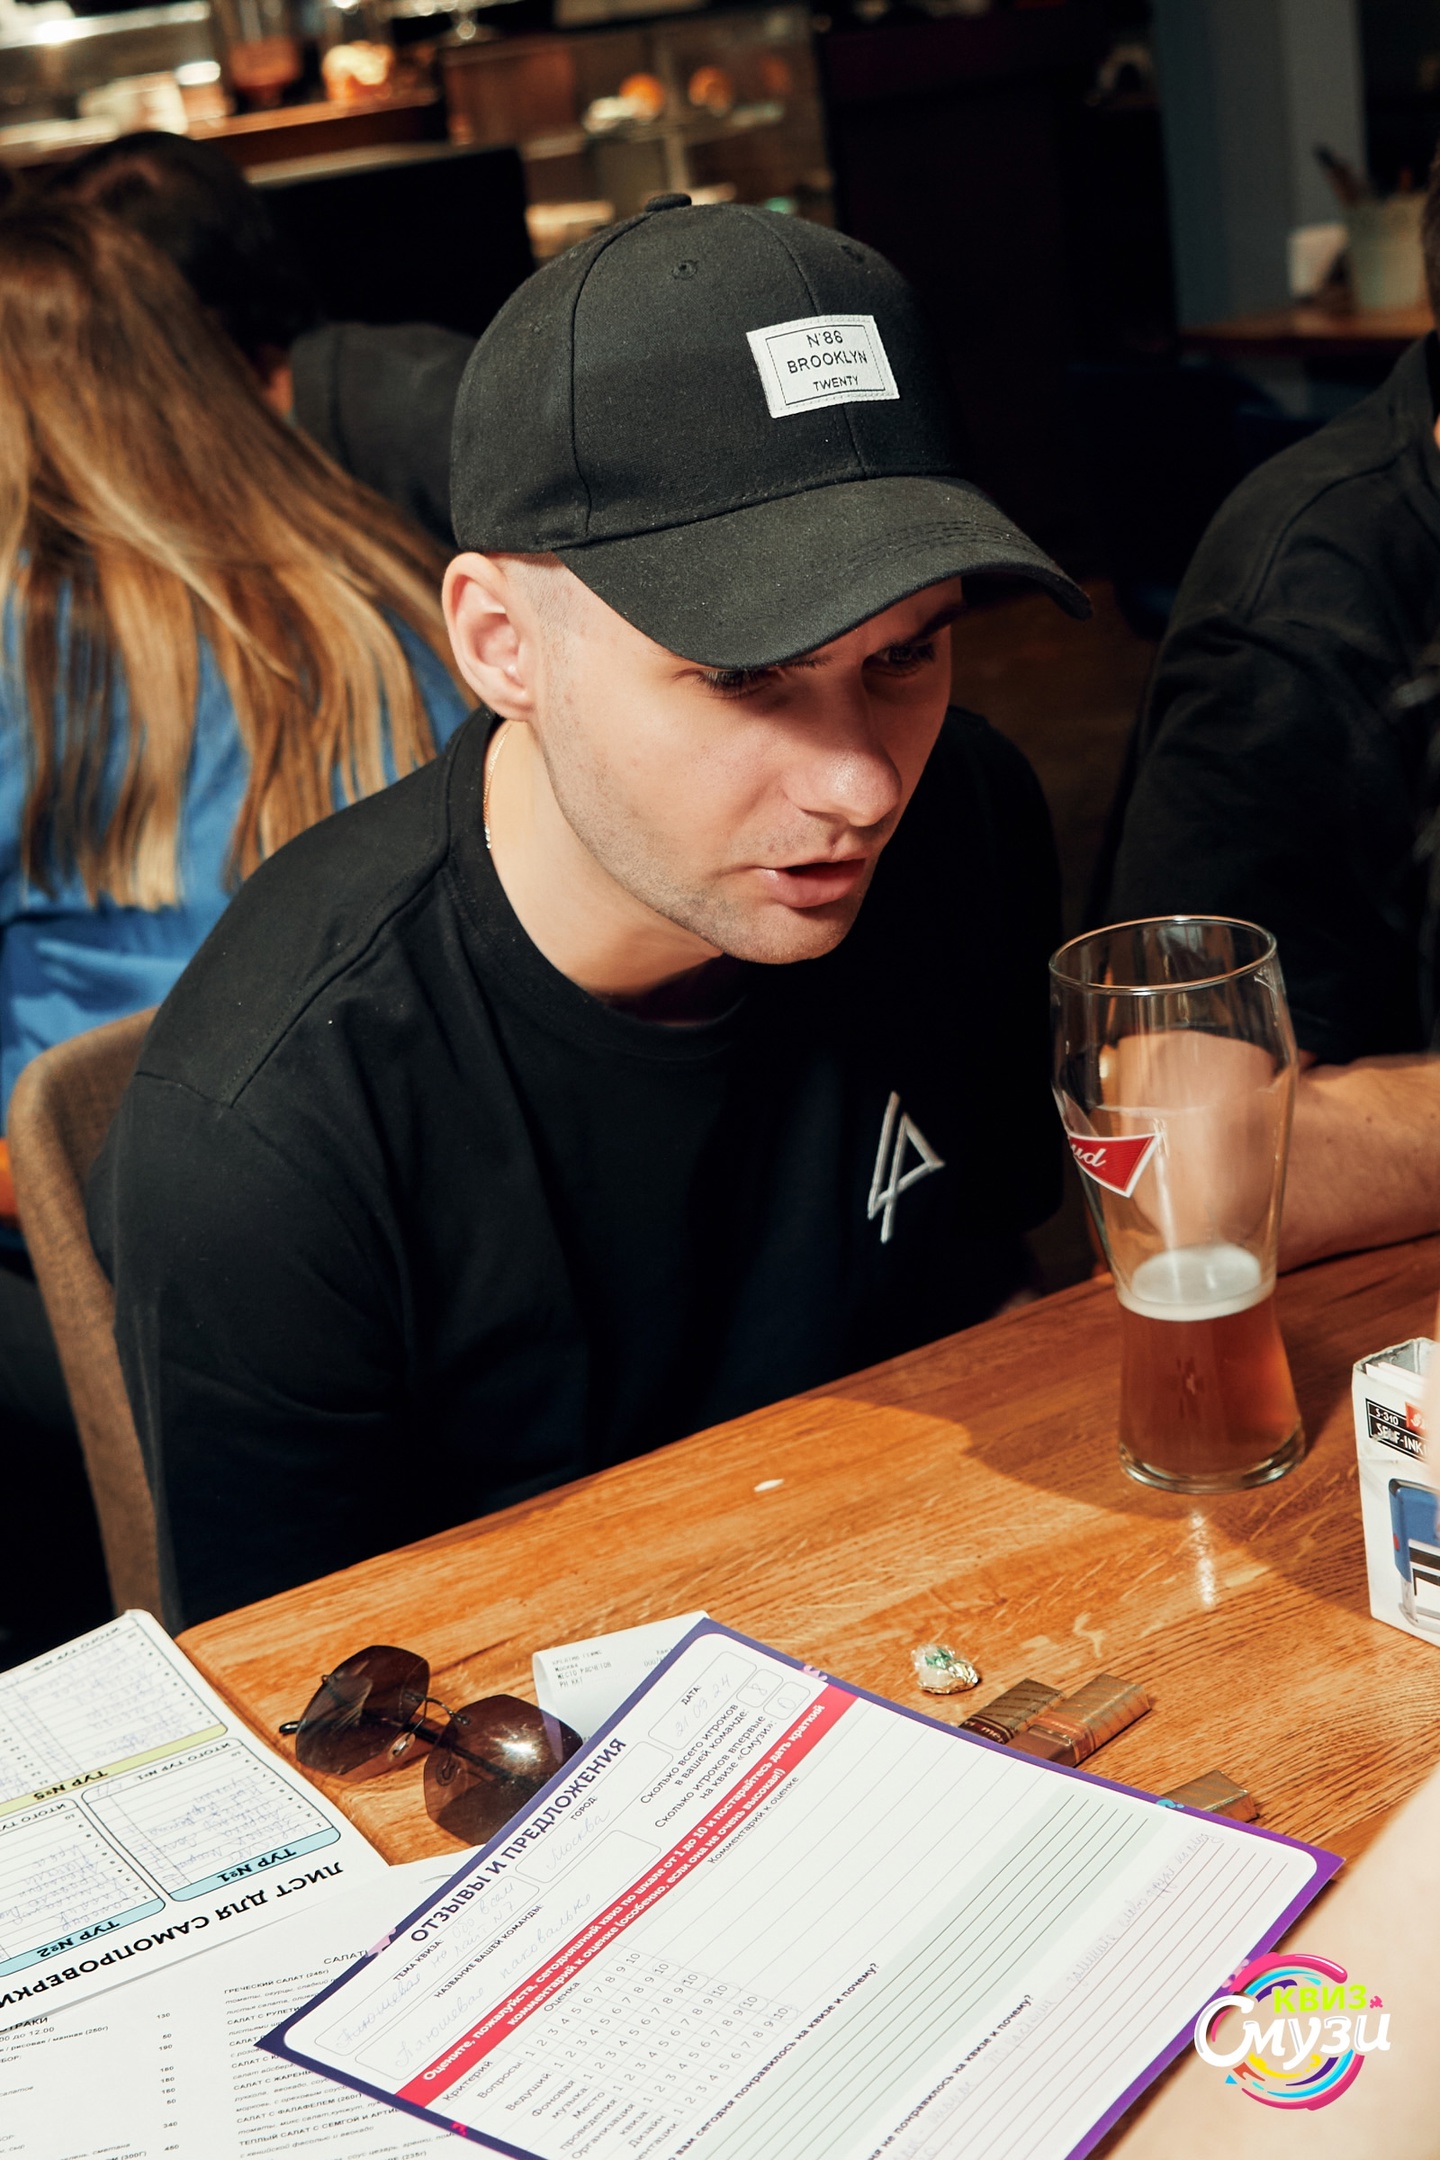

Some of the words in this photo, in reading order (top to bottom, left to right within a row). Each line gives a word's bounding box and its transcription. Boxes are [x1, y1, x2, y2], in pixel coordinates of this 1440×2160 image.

[786, 350, 867, 374] BROOKLYN
[812, 375, 858, 392] TWENTY
[1375, 1408, 1399, 1426] S-310
[681, 1685, 701, 1705] ДАТА:
[187, 1742, 231, 1762] ИТОГО
[640, 1767, 680, 1804] Сколько
[678, 1741, 704, 1767] всего
[702, 1704, 739, 1743] игроков
[674, 1779, 684, 1787] в
[683, 1749, 712, 1779] вашей
[710, 1709, 750, 1750] команде:
[699, 1787, 714, 1800] на
[712, 1761, 739, 1787] квизе
[737, 1720, 778, 1762] «Смузи»:
[71, 1769, 109, 1788] ТУР
[161, 1759, 185, 1773] ТУР
[654, 1791, 695, 1829] Сколько
[692, 1755, 731, 1794] игроков
[729, 1715, 766, 1756] впервые
[33, 1783, 66, 1800] №5
[21, 1803, 66, 1822] ИТОГО
[570, 1795, 598, 1821] ГОРОД:
[707, 1811, 766, 1864] Комментарий
[770, 1775, 800, 1806] оценке
[411, 1876, 491, 1942] ОТЗЫВЫ
[485, 1860, 507, 1875] И
[501, 1737, 627, 1860] ПРЕДЛОЖЕНИЯ
[257, 1847, 297, 1868] ТУР
[217, 1863, 253, 1882] №1
[276, 1861, 344, 1898] ЛИСТ
[214, 1889, 268, 1921] ДЛЯ
[423, 2040, 476, 2081] Оцените,
[473, 1985, 538, 2039] пожалуйста,
[535, 1922, 602, 1983] сегодняшний
[599, 1906, 624, 1926] квиз
[621, 1894, 637, 1907] по
[635, 1868, 666, 1895] шкале
[664, 1856, 678, 1868] от
[674, 1848, 685, 1857] 1
[682, 1838, 697, 1852] до
[697, 1826, 709, 1839] 10
[706, 1819, 717, 1828] и
[713, 1761, 773, 1822] постарайтесь
[770, 1741, 792, 1764] дать
[789, 1704, 826, 1742] краткий
[507, 1964, 578, 2026] комментарий
[575, 1957, 586, 1967] к
[583, 1926, 619, 1959] оценке
[616, 1884, 670, 1927] (особенно,
[667, 1862, 692, 1884] если
[689, 1847, 709, 1864] она
[706, 1834, 720, 1848] не
[717, 1809, 746, 1836] очень
[743, 1767, 787, 1812] высокая!)
[79, 1920, 120, 1940] ТУР
[36, 1937, 74, 1958] №2
[393, 1962, 417, 1982] ТЕМА
[415, 1939, 444, 1963] КВИЗА:
[434, 1962, 477, 1999] НАЗВАНИЕ
[475, 1937, 504, 1964] ВАШЕЙ
[502, 1904, 544, 1939] КОМАНДЫ:
[0, 1915, 210, 2010] САМОПРОВЕРКИ
[224, 1978, 275, 1994] ГРЕЧЕСКИЙ
[276, 1974, 304, 1985] САЛАТ
[543, 1981, 581, 2013] Оценка
[227, 2015, 255, 2025] САЛАТ
[525, 2050, 536, 2058] 1
[537, 2039, 548, 2047] 2
[548, 2028, 558, 2036] 3
[571, 2007, 582, 2015] 5
[583, 1996, 593, 2004] 6
[594, 1986, 604, 1994] 7
[605, 1975, 615, 1983] 8
[616, 1965, 626, 1973] 9
[626, 1953, 641, 1964] 10
[229, 2036, 257, 2047] САЛАТ
[231, 2058, 260, 2069] САЛАТ
[675, 2137, 696, 2156] вам
[696, 2100, 735, 2137] сегодня
[734, 2041, 797, 2100] понравилось
[795, 2029, 809, 2041] на
[808, 2004, 835, 2029] квизе
[834, 1997, 843, 2005] и
[841, 1962, 879, 1998] почему?
[881, 2135, 895, 2148] не
[894, 2075, 955, 2135] понравилось
[952, 2062, 966, 2075] на
[964, 2037, 992, 2063] квизе
[997, 1994, 1034, 2031] почему?
[233, 2081, 262, 2091] САЛАТ
[443, 2059, 494, 2102] Критерий
[237, 2113, 266, 2124] САЛАТ
[277, 2098, 336, 2115] ФАЛАФЕЛЕМ
[531, 2079, 576, 2118] Фоновая
[572, 2091, 606, 2120] Место
[280, 2127, 310, 2138] САЛАТ
[322, 2116, 360, 2129] СЕМГОЙ
[571, 2103, 636, 2160] Организация
[628, 2113, 667, 2148] Дизайн
